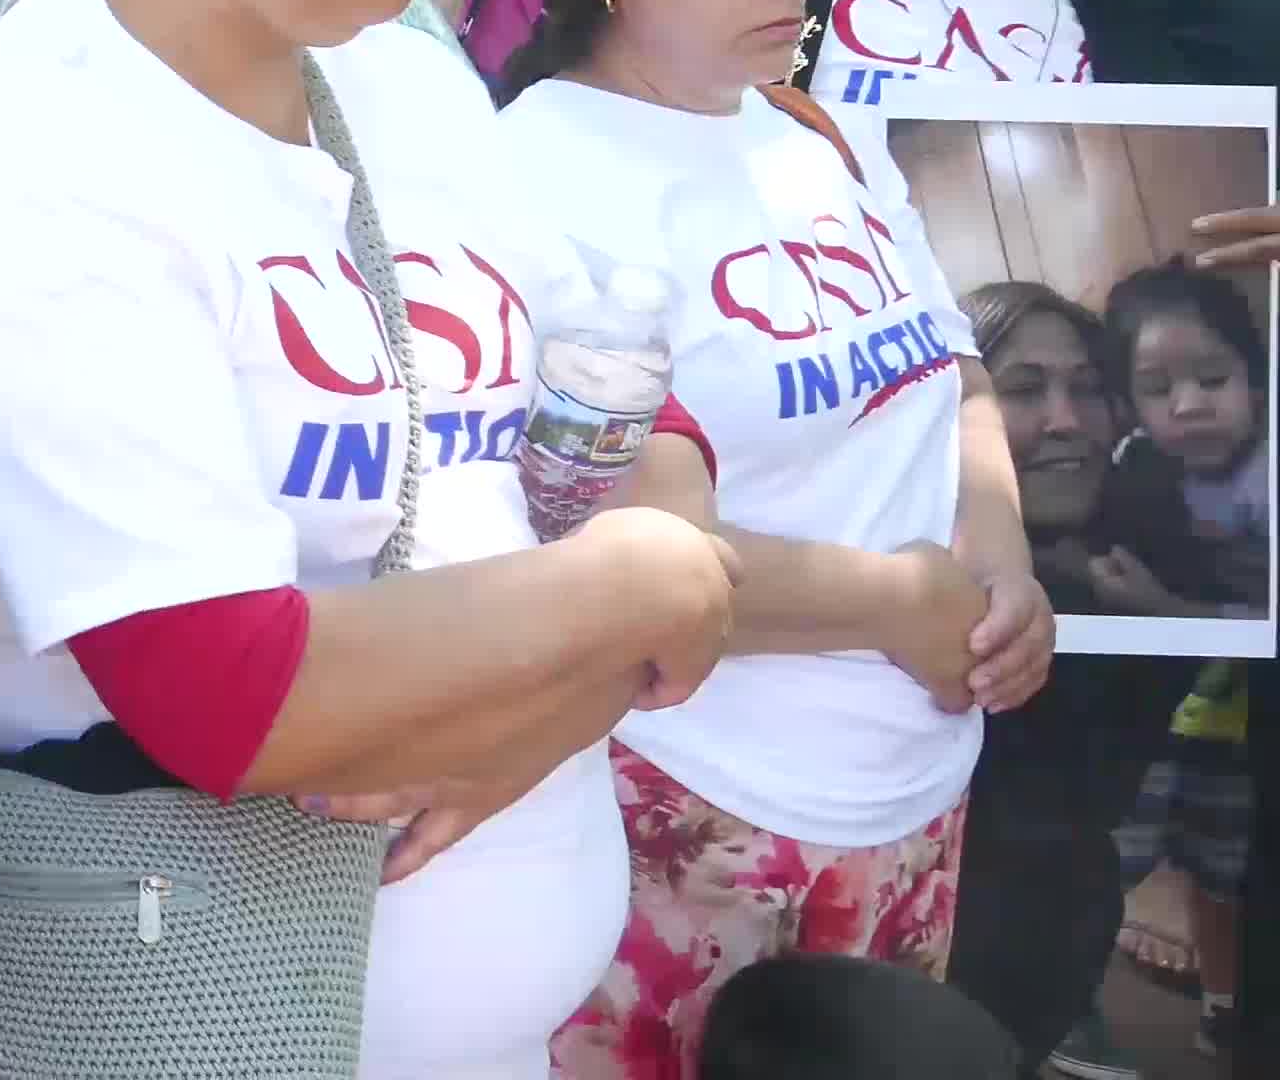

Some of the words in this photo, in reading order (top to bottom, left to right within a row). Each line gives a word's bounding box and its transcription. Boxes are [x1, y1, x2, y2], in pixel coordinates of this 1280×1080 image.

[710, 199, 911, 341] CASA
[776, 353, 840, 419] IN
[848, 311, 951, 399] ACTIO
[280, 422, 390, 501] IN
